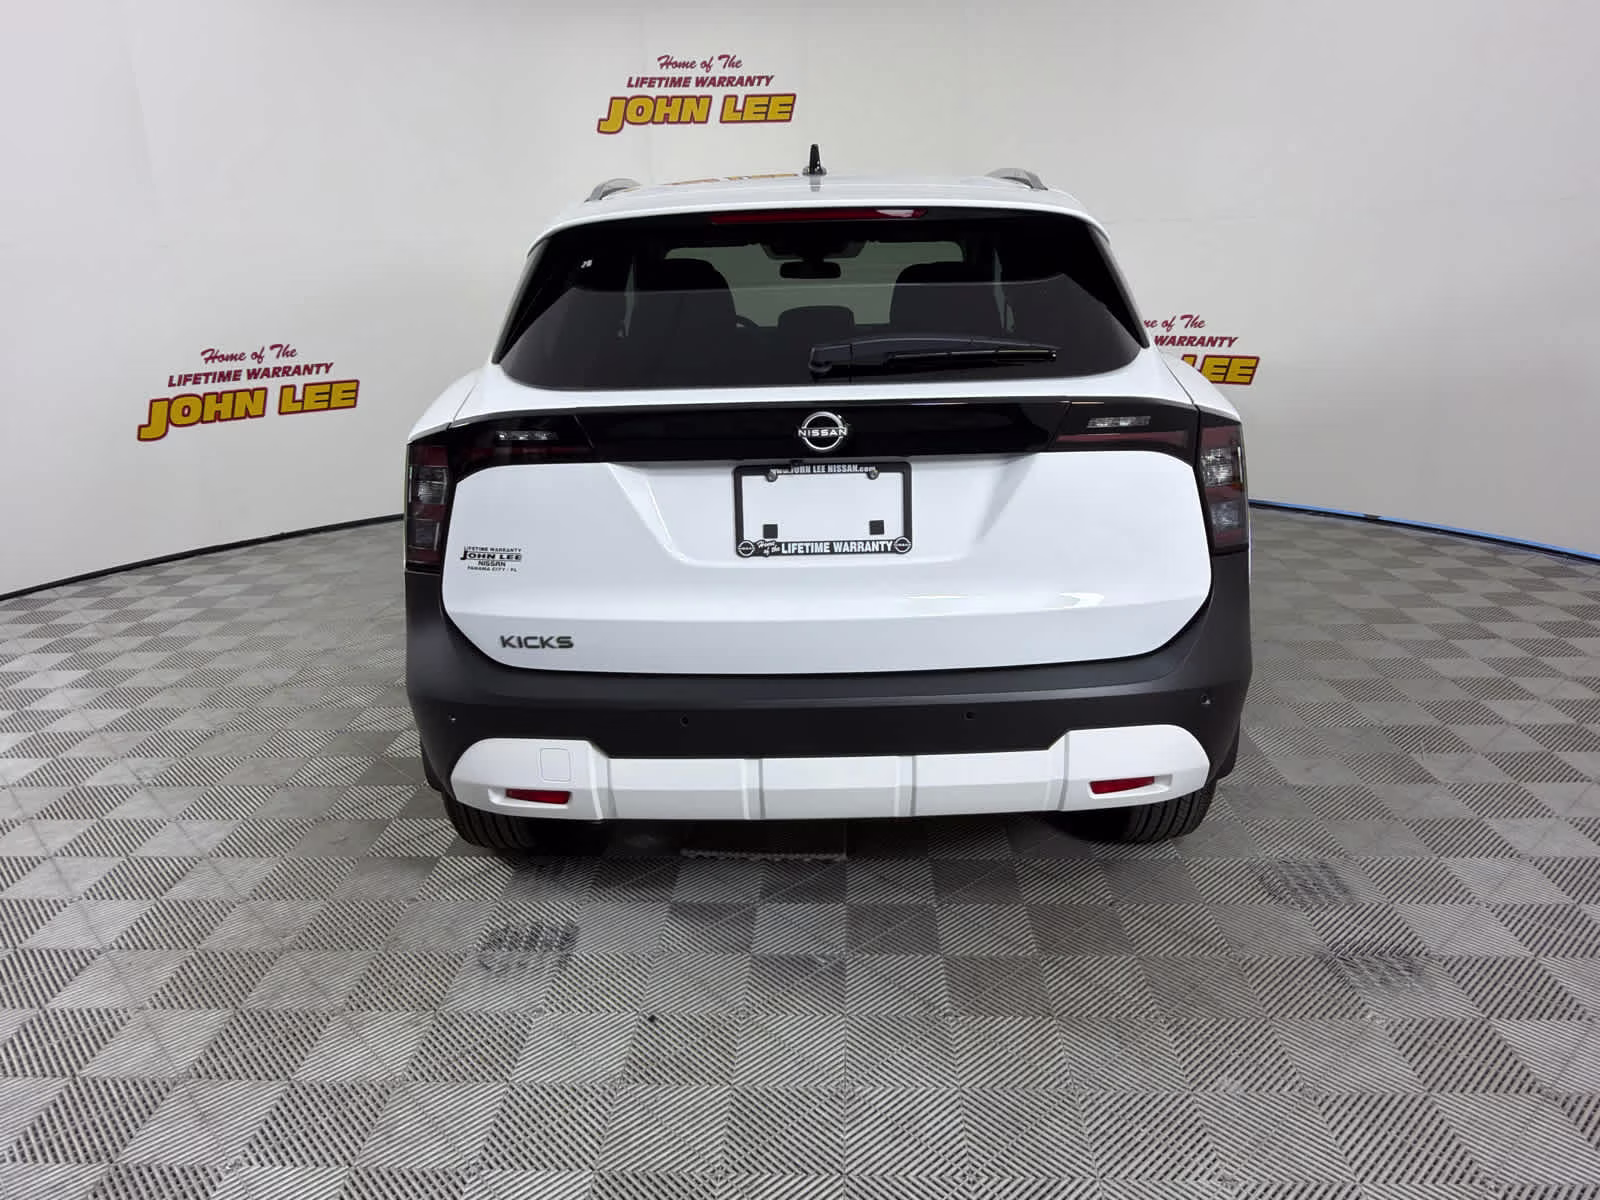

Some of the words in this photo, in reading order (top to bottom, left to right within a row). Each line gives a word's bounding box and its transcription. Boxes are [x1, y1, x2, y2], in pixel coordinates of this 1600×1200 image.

[657, 55, 696, 69] Home
[700, 56, 714, 73] of
[717, 54, 743, 69] The
[627, 76, 691, 88] LIFETIME
[695, 75, 774, 88] WARRANTY
[597, 95, 712, 134] JOHN
[720, 94, 796, 124] LEE
[1161, 316, 1176, 333] of
[1180, 314, 1206, 329] The
[1154, 335, 1239, 347] WARRANTY
[200, 348, 247, 364] Home
[250, 347, 265, 364] of
[269, 343, 297, 358] The
[167, 369, 242, 388] LIFETIME
[246, 362, 334, 381] WARRANTY
[137, 387, 268, 442] JOHN
[278, 379, 360, 415] LEE
[798, 427, 848, 437] NISSAN
[812, 464, 826, 473] LEE
[781, 541, 831, 554] LIFETIME
[832, 540, 893, 553] WARRANTY
[460, 551, 496, 561] JOHN
[500, 635, 574, 649] KICKS
